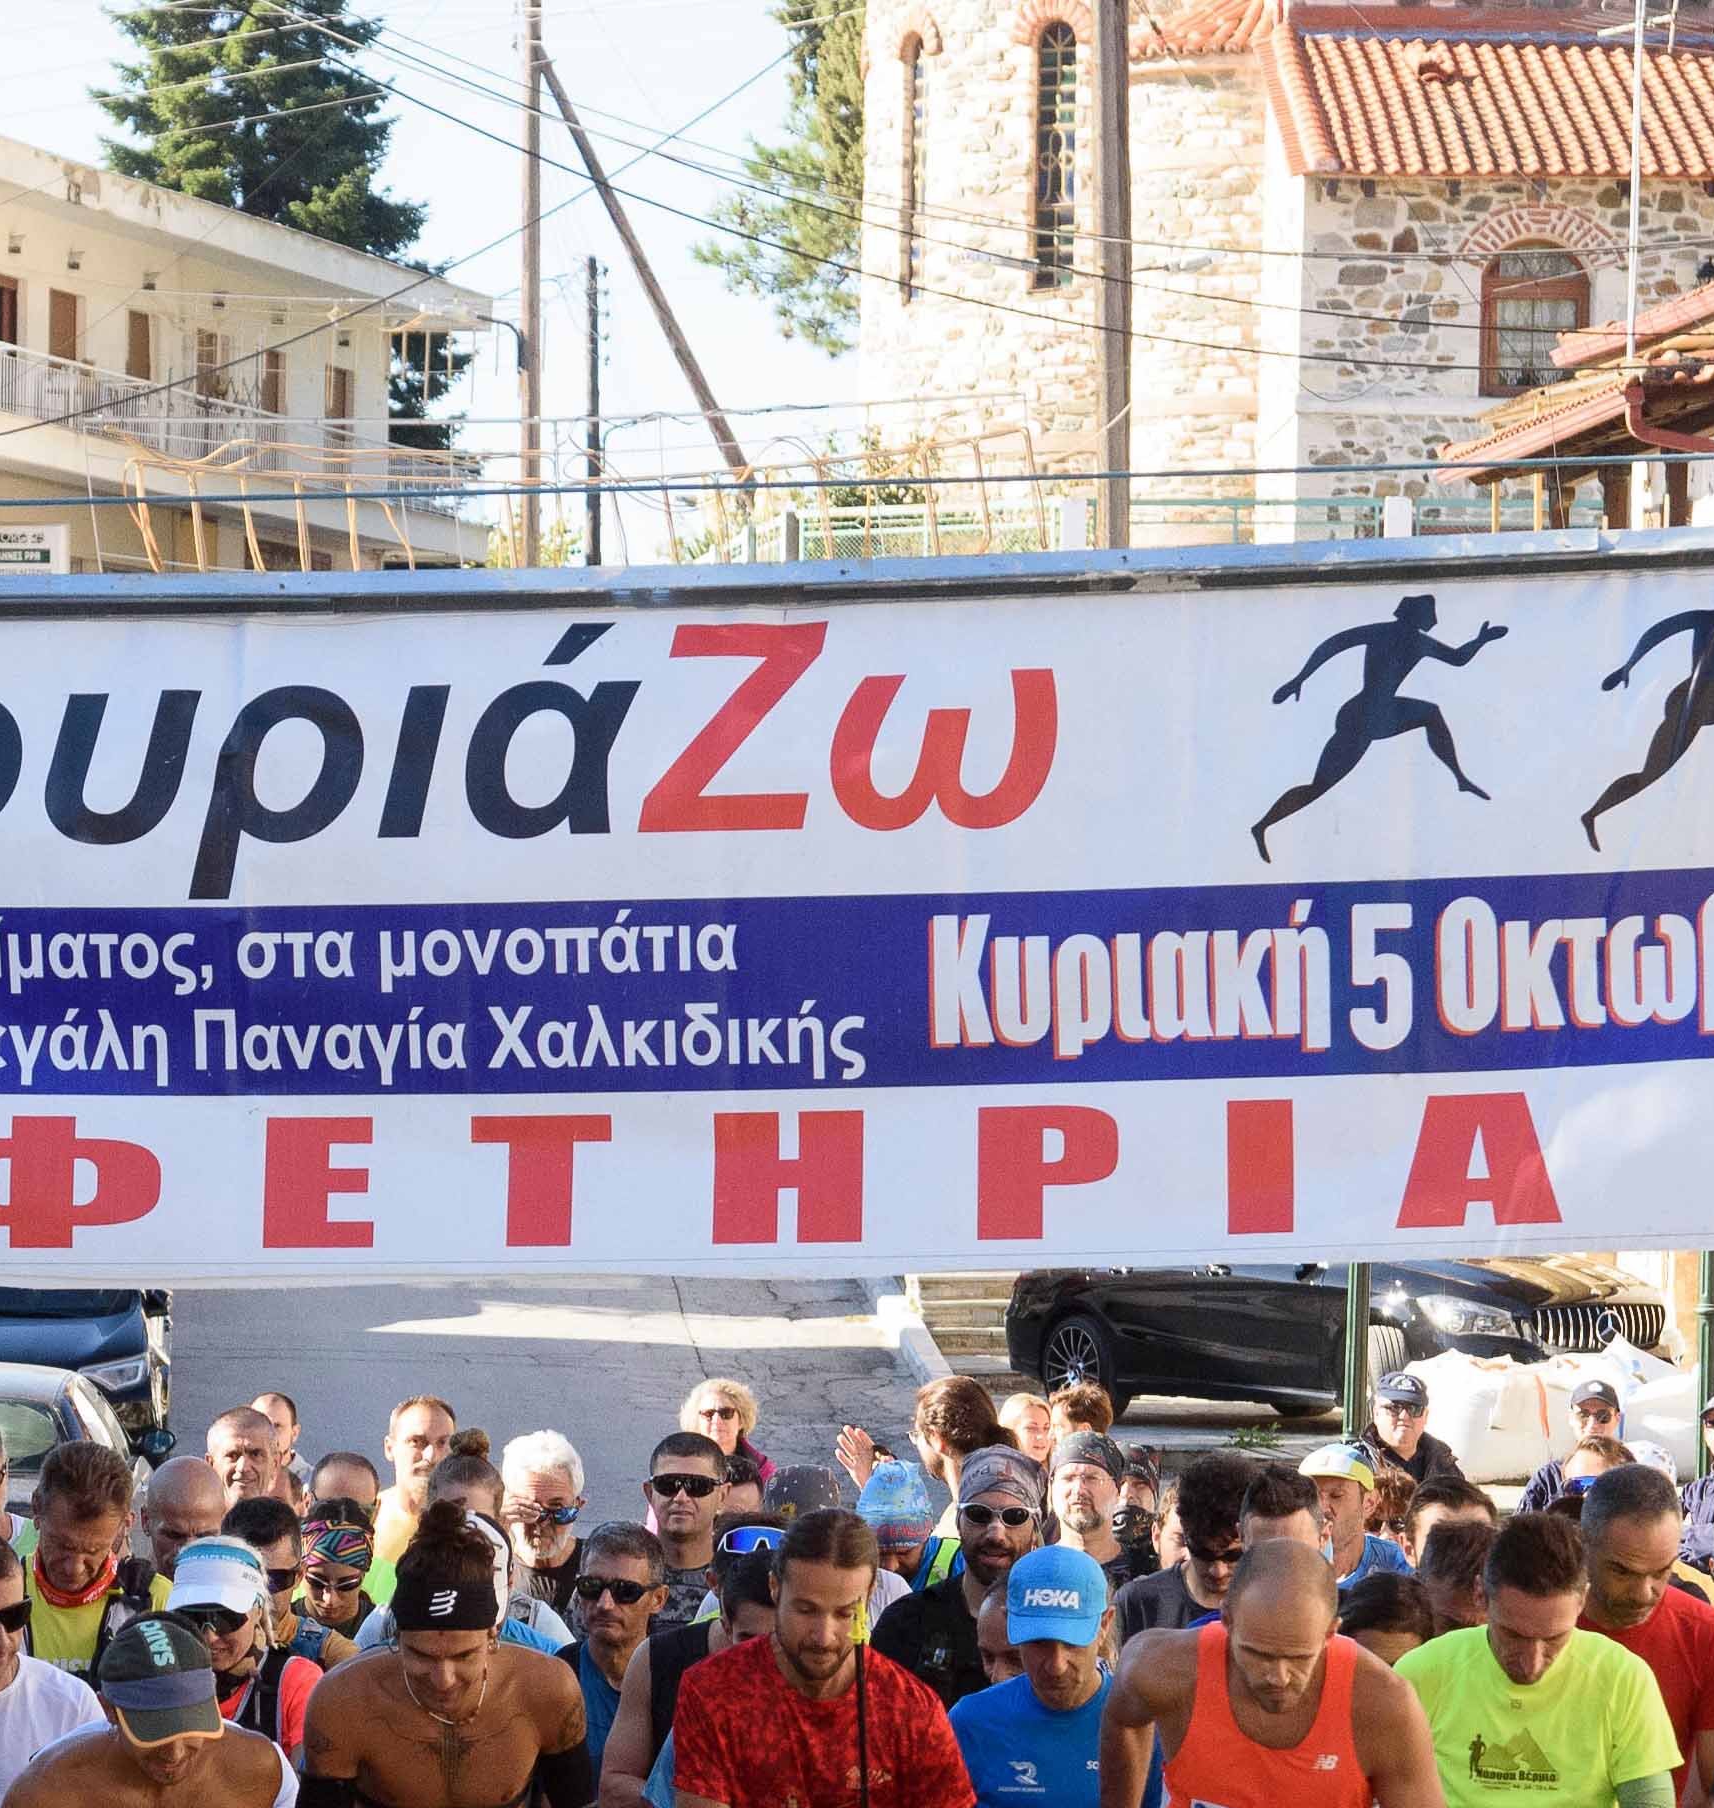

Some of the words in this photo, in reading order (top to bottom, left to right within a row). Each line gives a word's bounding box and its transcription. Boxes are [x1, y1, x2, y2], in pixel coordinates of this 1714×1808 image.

[237, 930, 353, 979] στα
[380, 909, 737, 994] μονοπάτια
[929, 898, 1332, 1060] Κυριακή
[1349, 901, 1414, 1051] 5
[194, 1006, 466, 1085] Παναγία
[488, 1000, 865, 1080] Χαλκιδικής
[1023, 1588, 1080, 1609] HOKA
